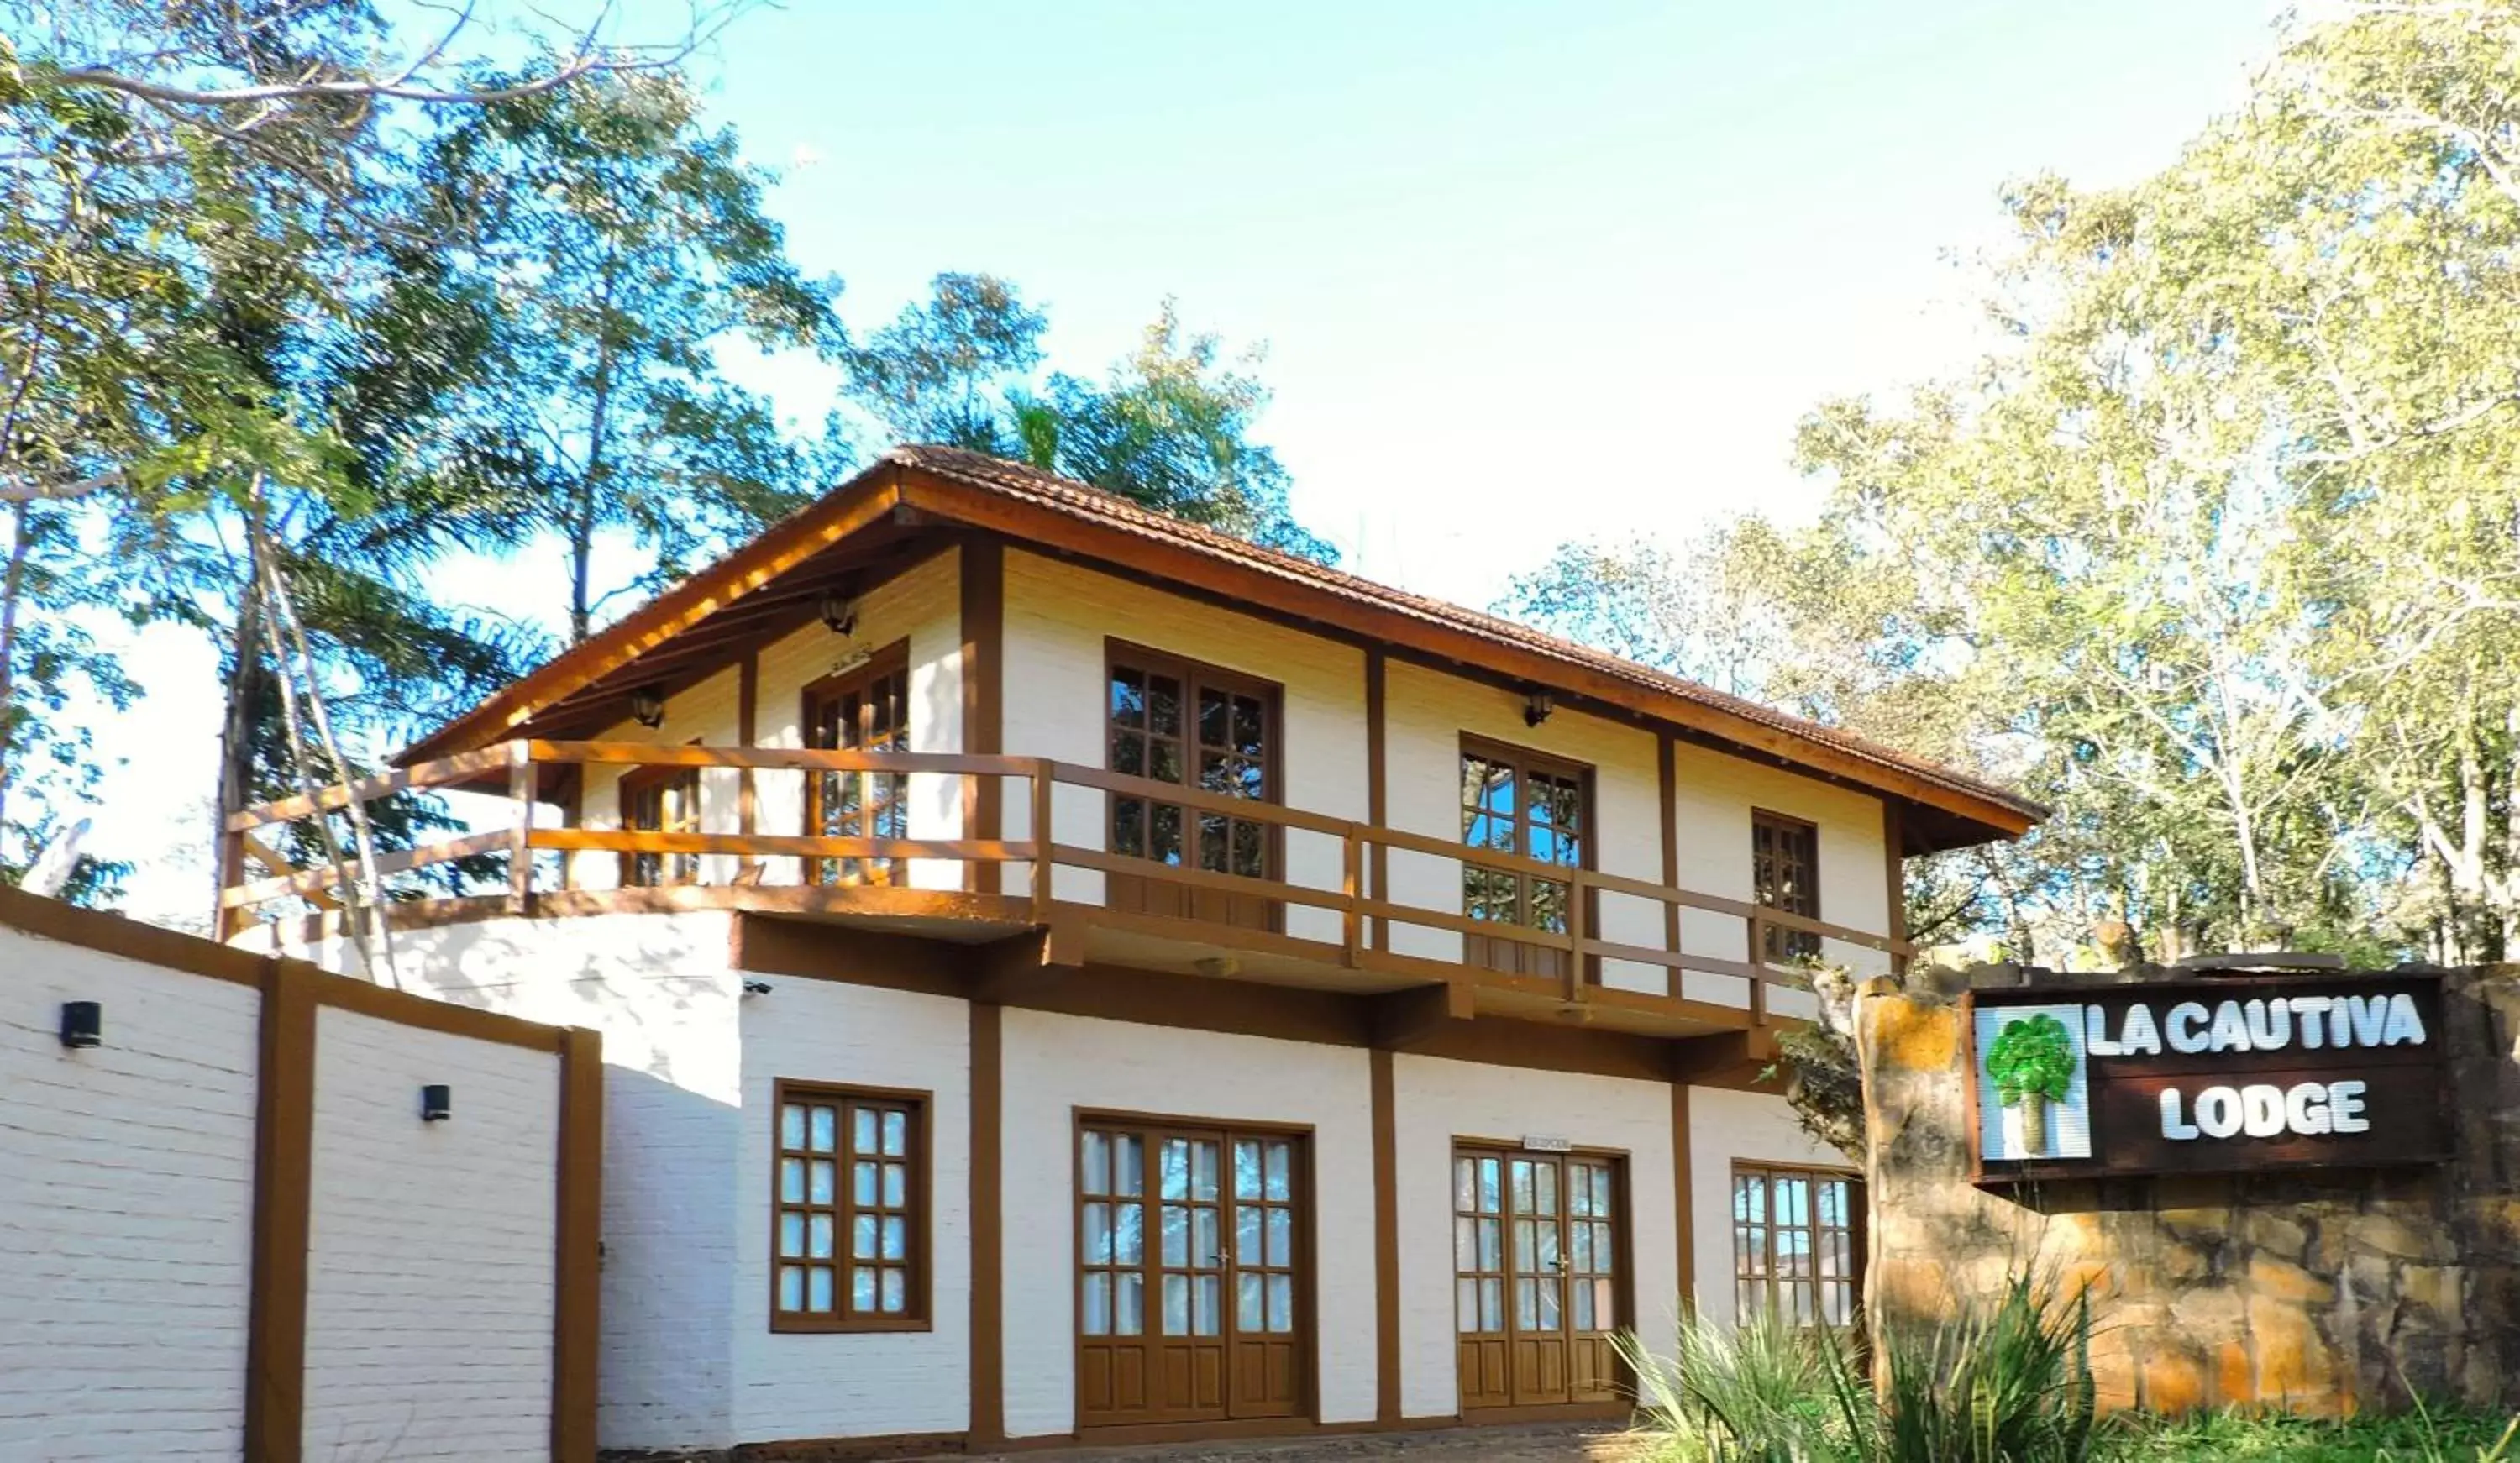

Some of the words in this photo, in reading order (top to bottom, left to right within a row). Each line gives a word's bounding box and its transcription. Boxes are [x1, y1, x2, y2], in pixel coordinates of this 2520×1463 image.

[2087, 1004, 2161, 1056] LA
[2165, 994, 2426, 1054] CAUTIVA
[2160, 1080, 2370, 1140] LODGE
